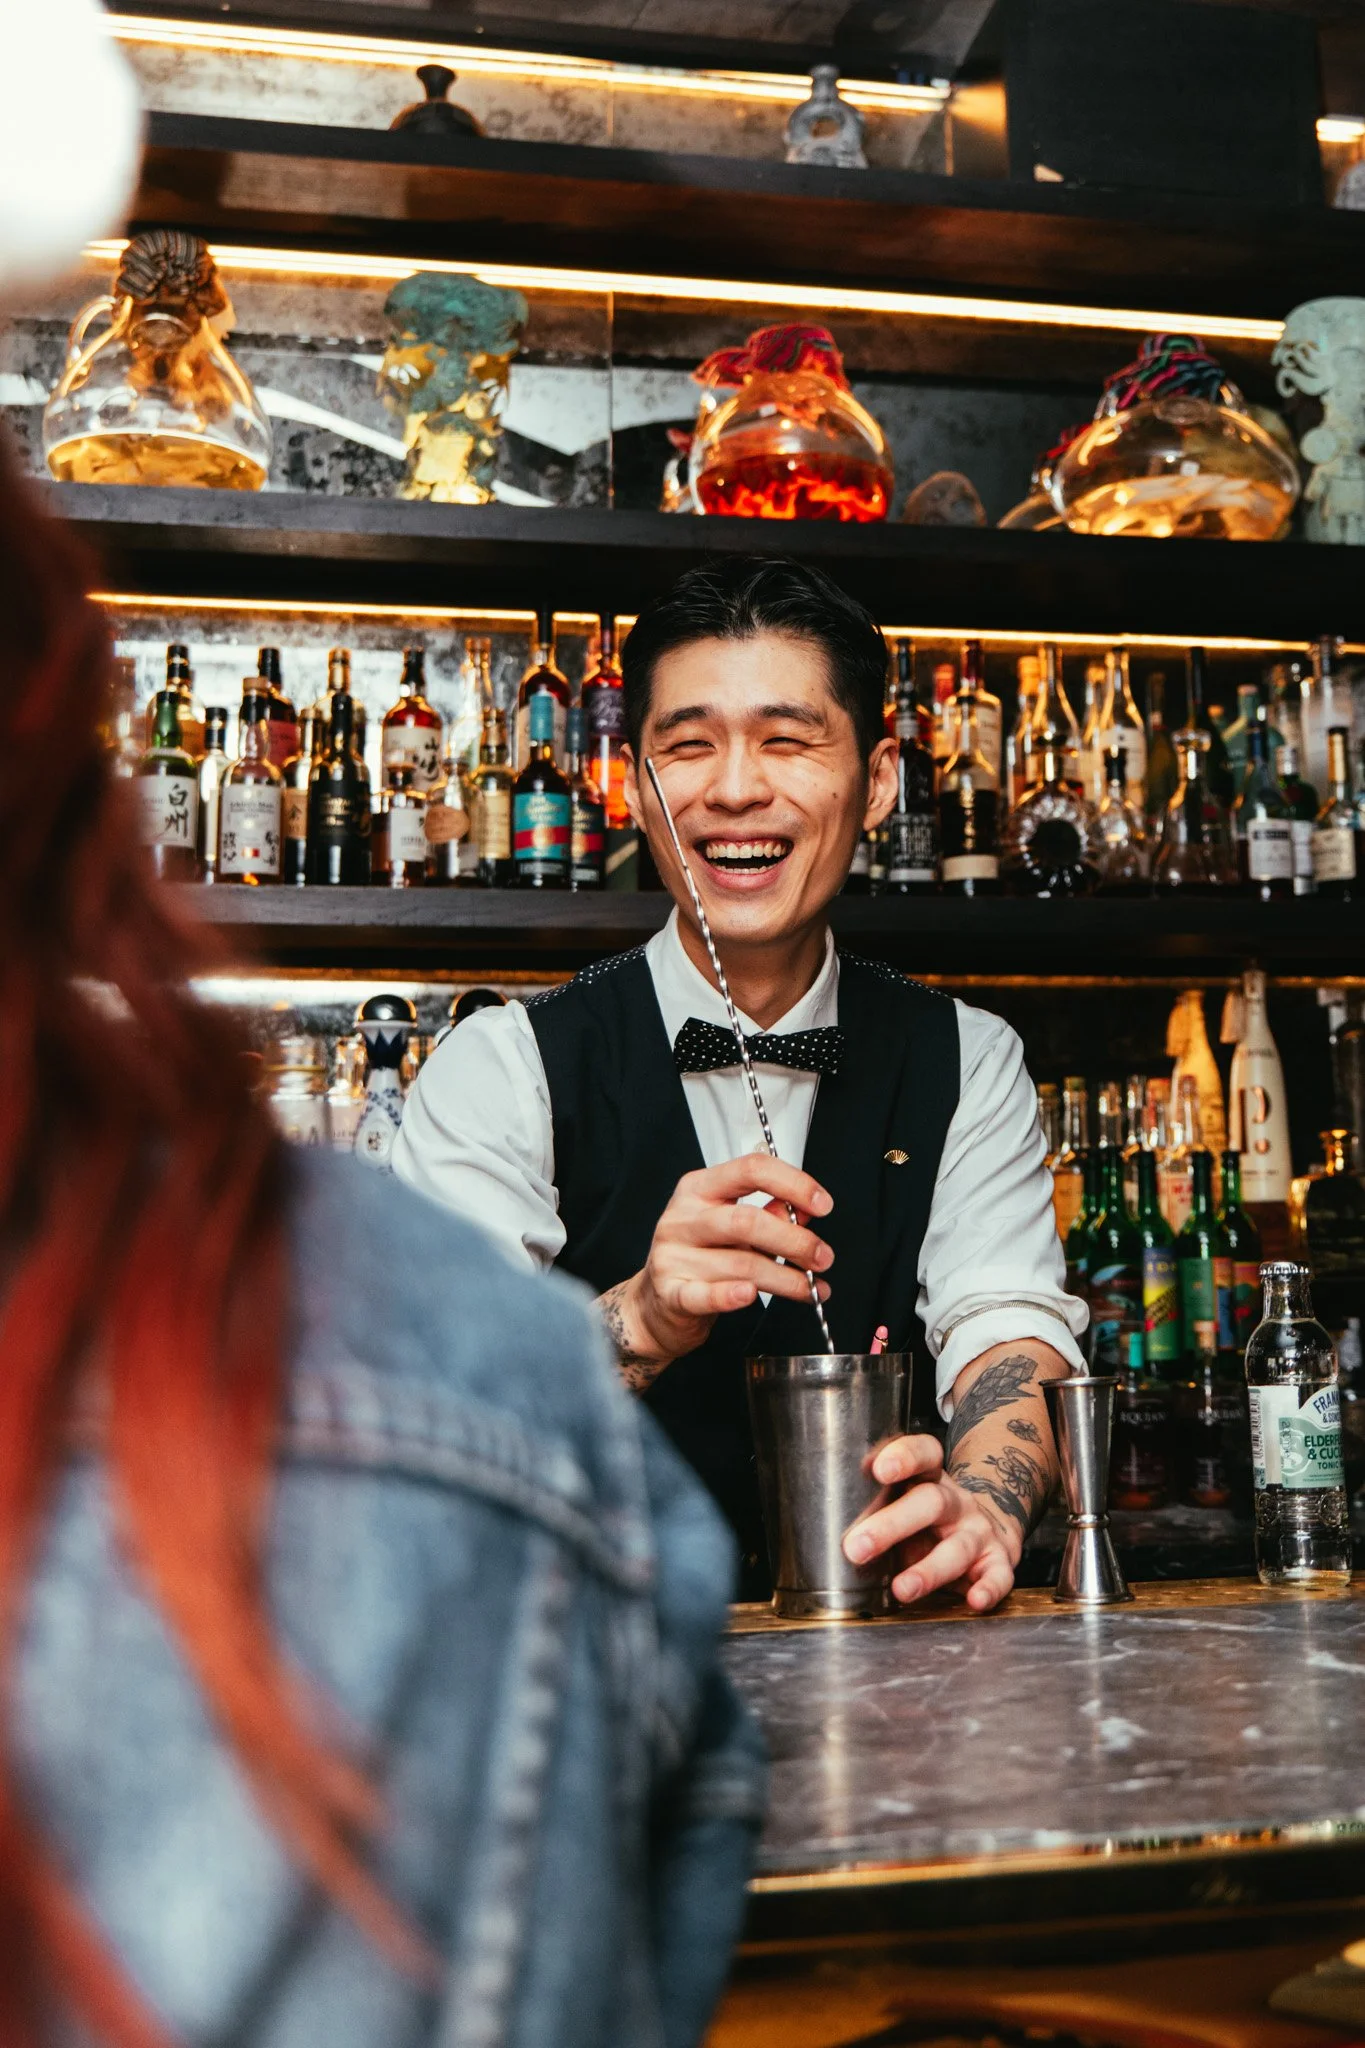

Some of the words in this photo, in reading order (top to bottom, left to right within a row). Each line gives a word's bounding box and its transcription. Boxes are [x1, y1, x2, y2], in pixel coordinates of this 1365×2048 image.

[1313, 1390, 1340, 1414] FRAN
[1307, 1448, 1318, 1461] &
[1317, 1462, 1339, 1470] TONIC
